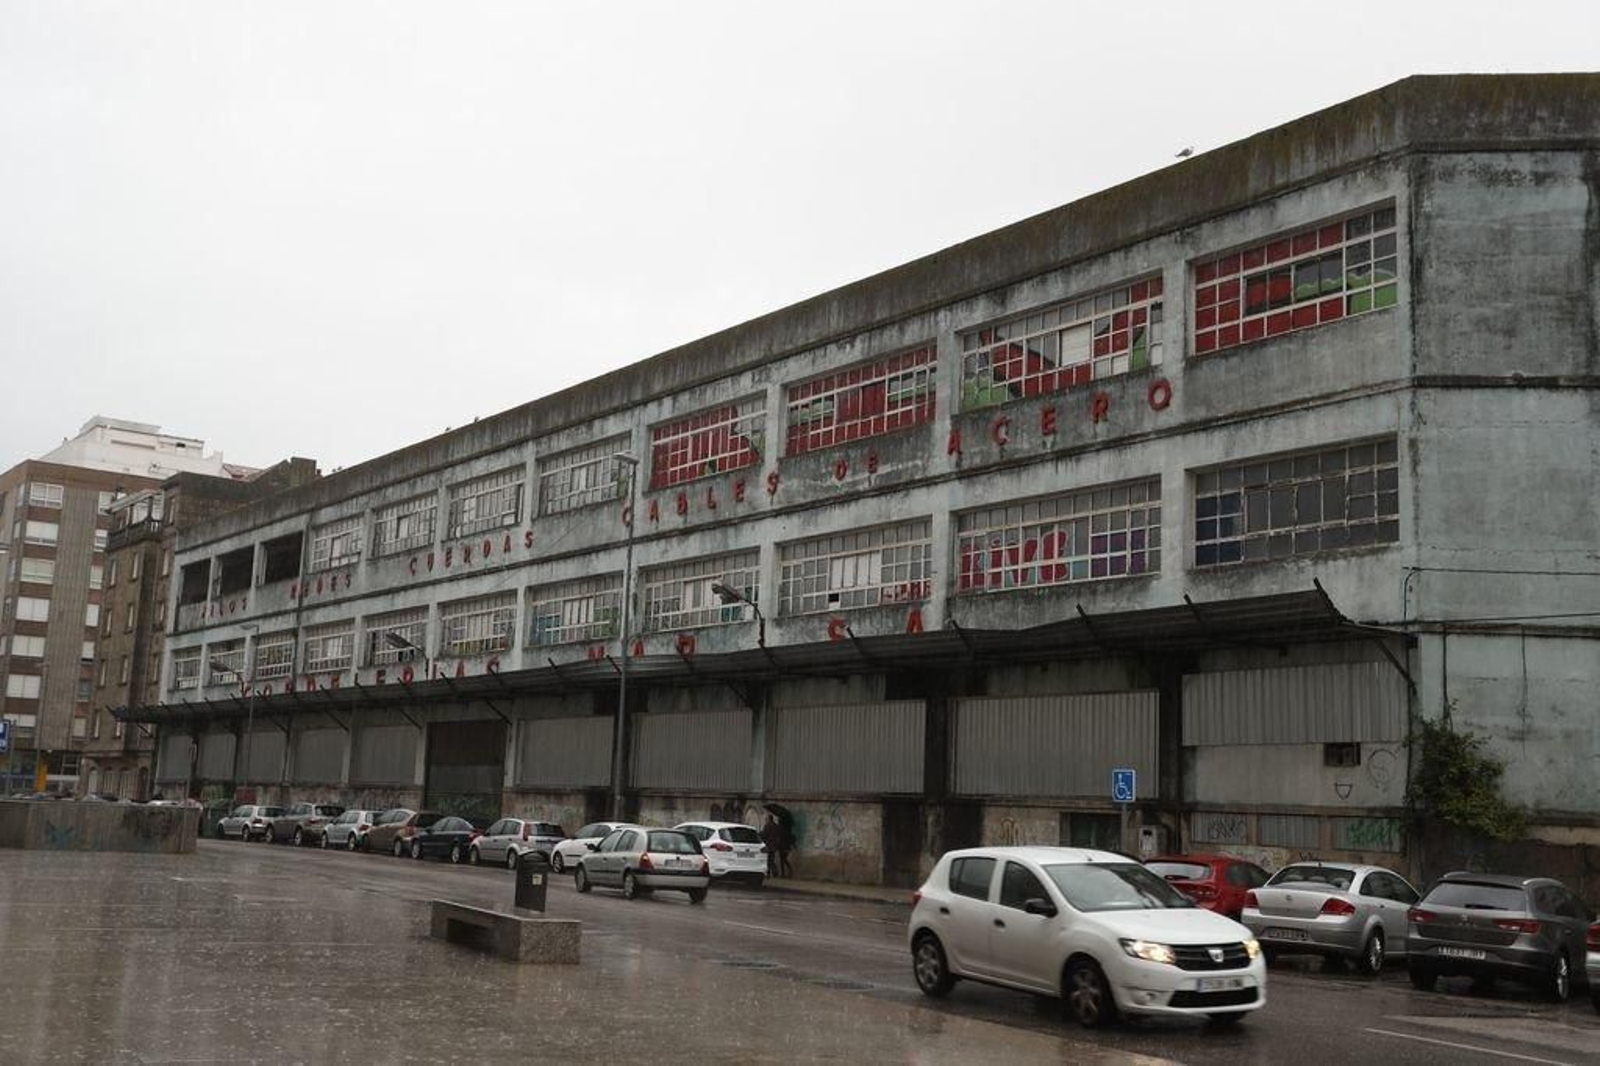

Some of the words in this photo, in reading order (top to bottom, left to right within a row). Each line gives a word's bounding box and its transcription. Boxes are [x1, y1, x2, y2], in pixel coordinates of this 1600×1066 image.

[409, 530, 533, 577] CUERDAS
[621, 470, 780, 528] CABLES
[834, 452, 879, 482] DE
[947, 378, 1173, 457] ACERO
